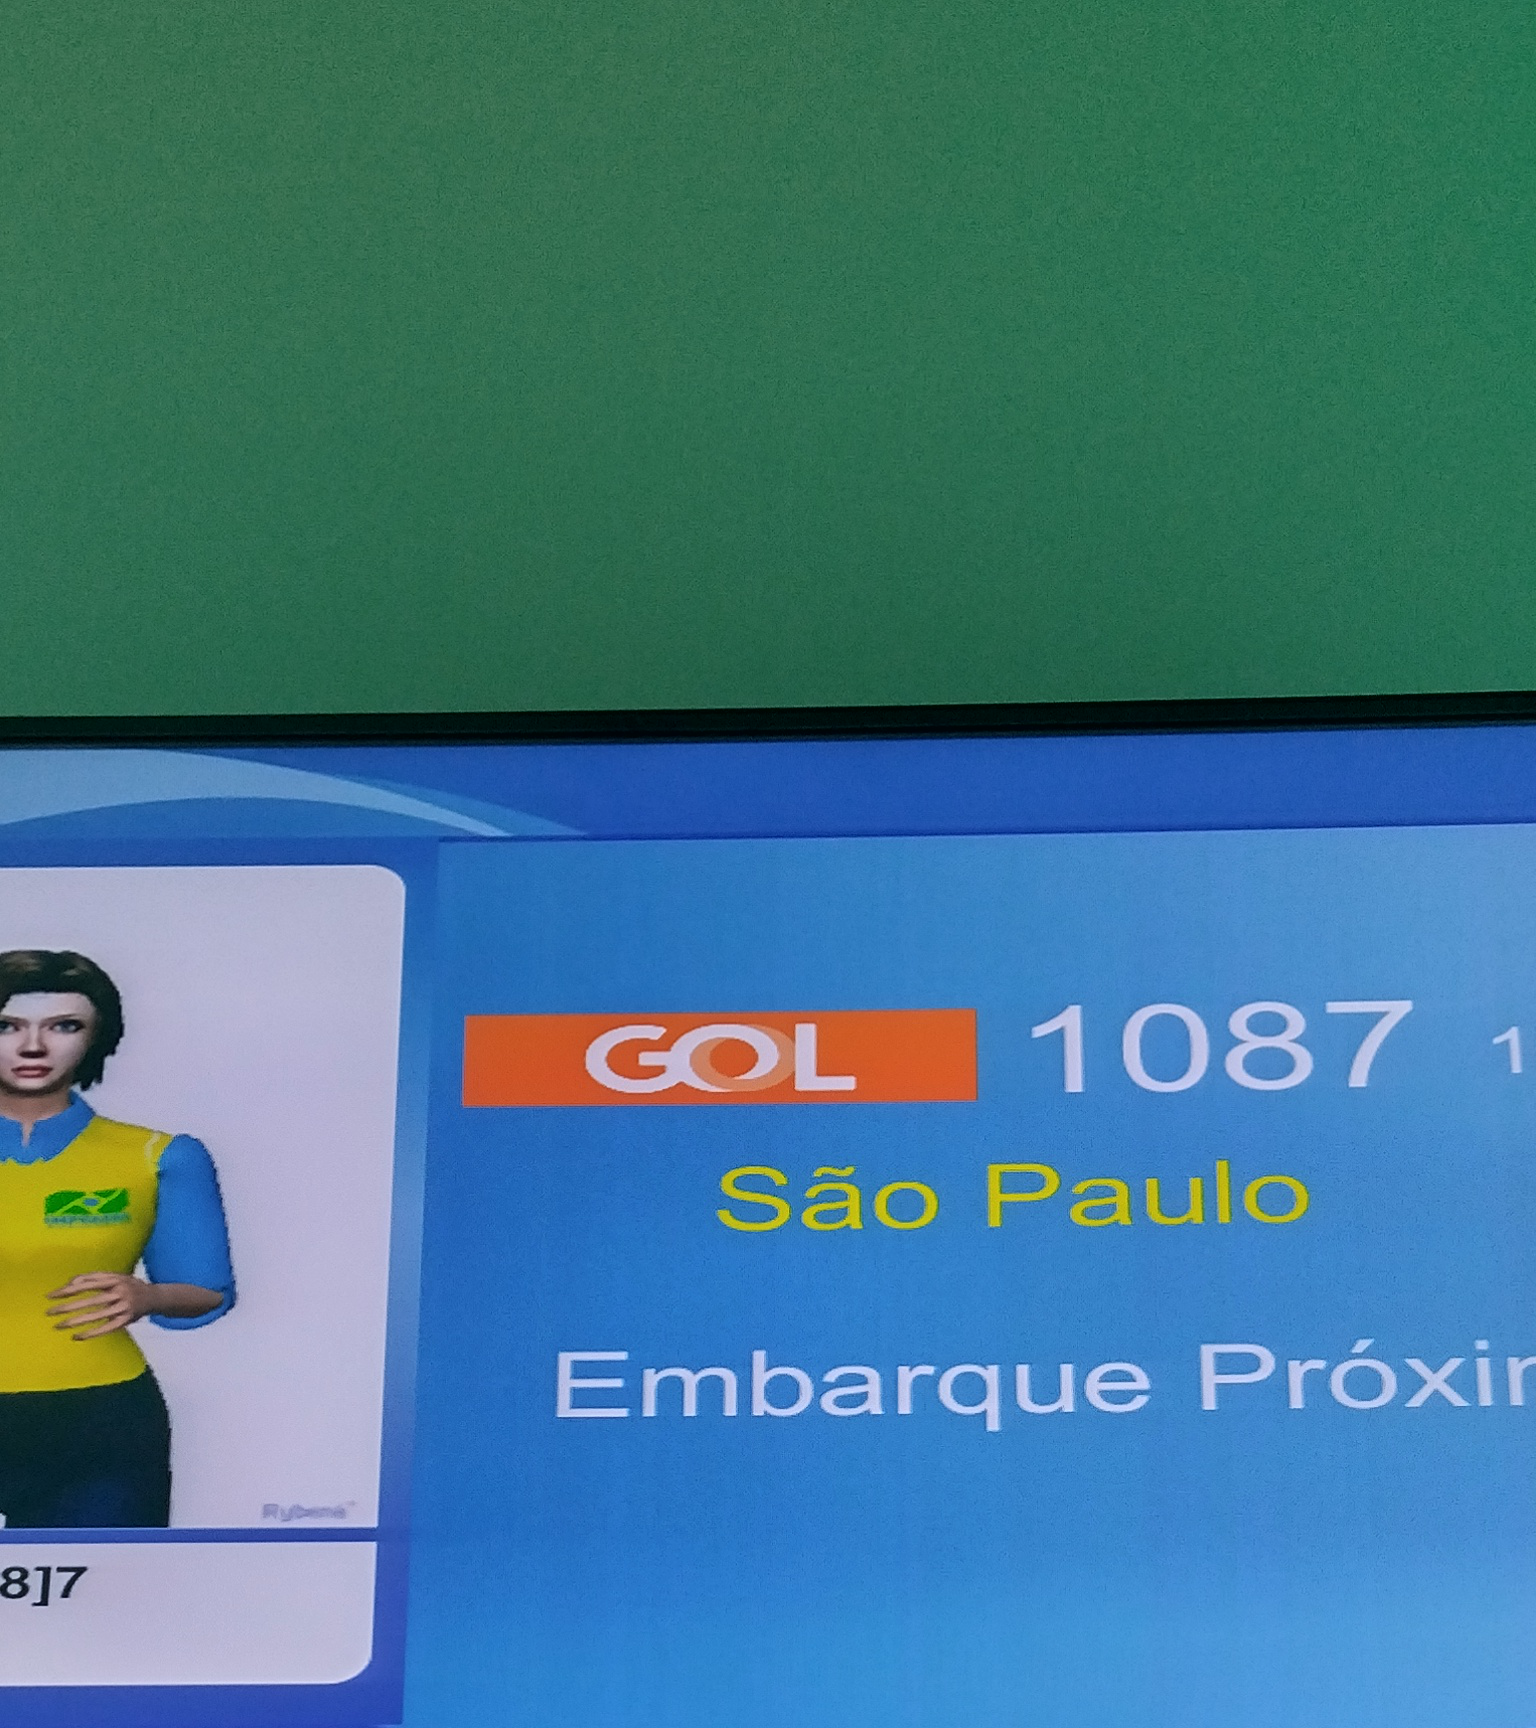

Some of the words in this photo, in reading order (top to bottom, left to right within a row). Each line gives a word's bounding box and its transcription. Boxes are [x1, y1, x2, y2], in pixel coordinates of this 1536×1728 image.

[585, 1022, 857, 1094] GOL
[1030, 1000, 1414, 1093] 1087
[716, 1165, 940, 1232] São
[986, 1159, 1311, 1228] Paulo
[555, 1350, 1152, 1432] Embarque
